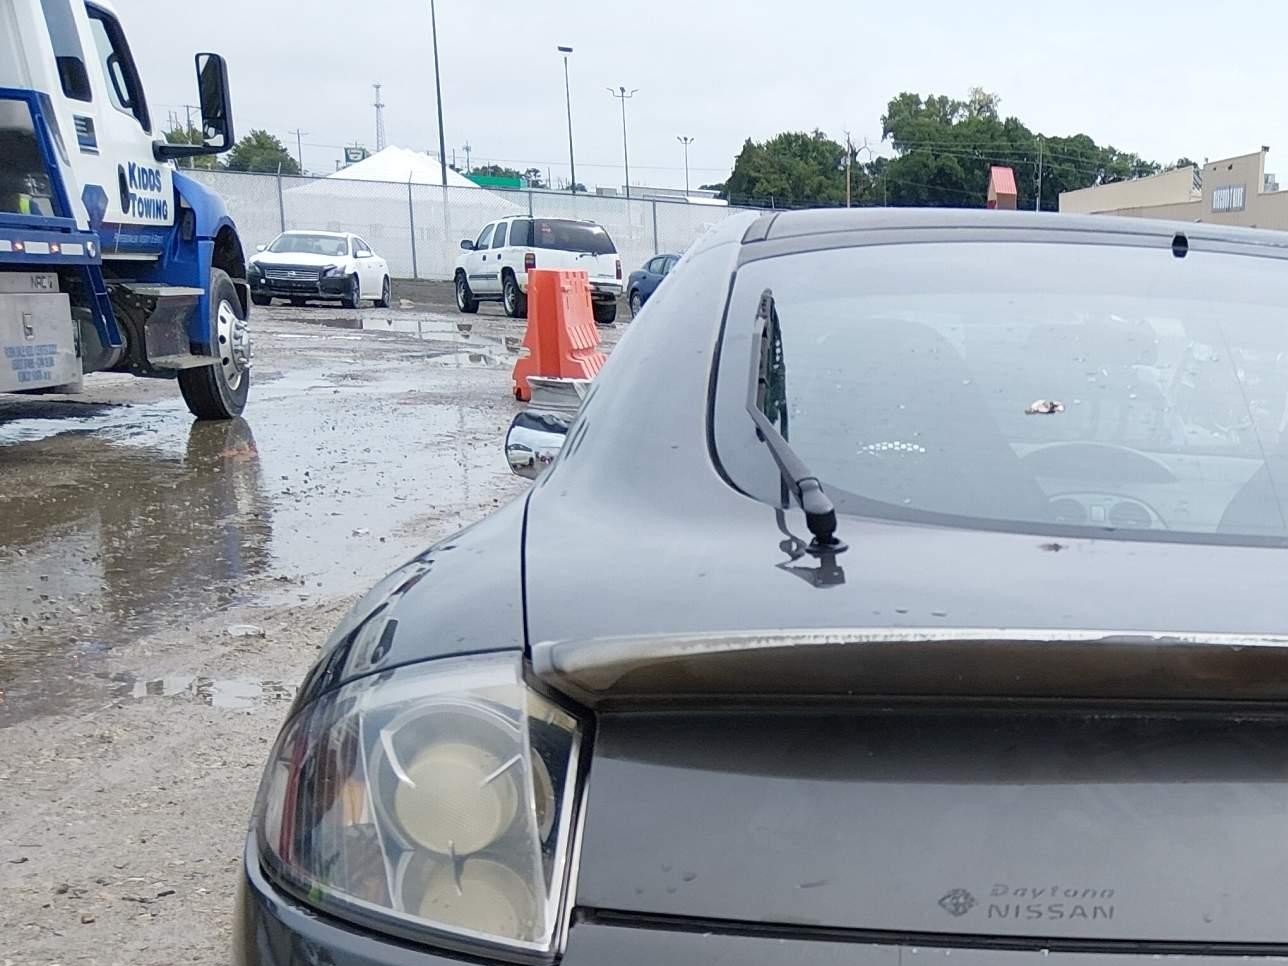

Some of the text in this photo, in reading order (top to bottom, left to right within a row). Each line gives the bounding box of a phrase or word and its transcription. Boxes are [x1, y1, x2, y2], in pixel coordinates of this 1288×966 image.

[128, 161, 162, 192] KIDDS
[129, 192, 168, 220] TOWING
[988, 903, 1115, 920] NISSAN
